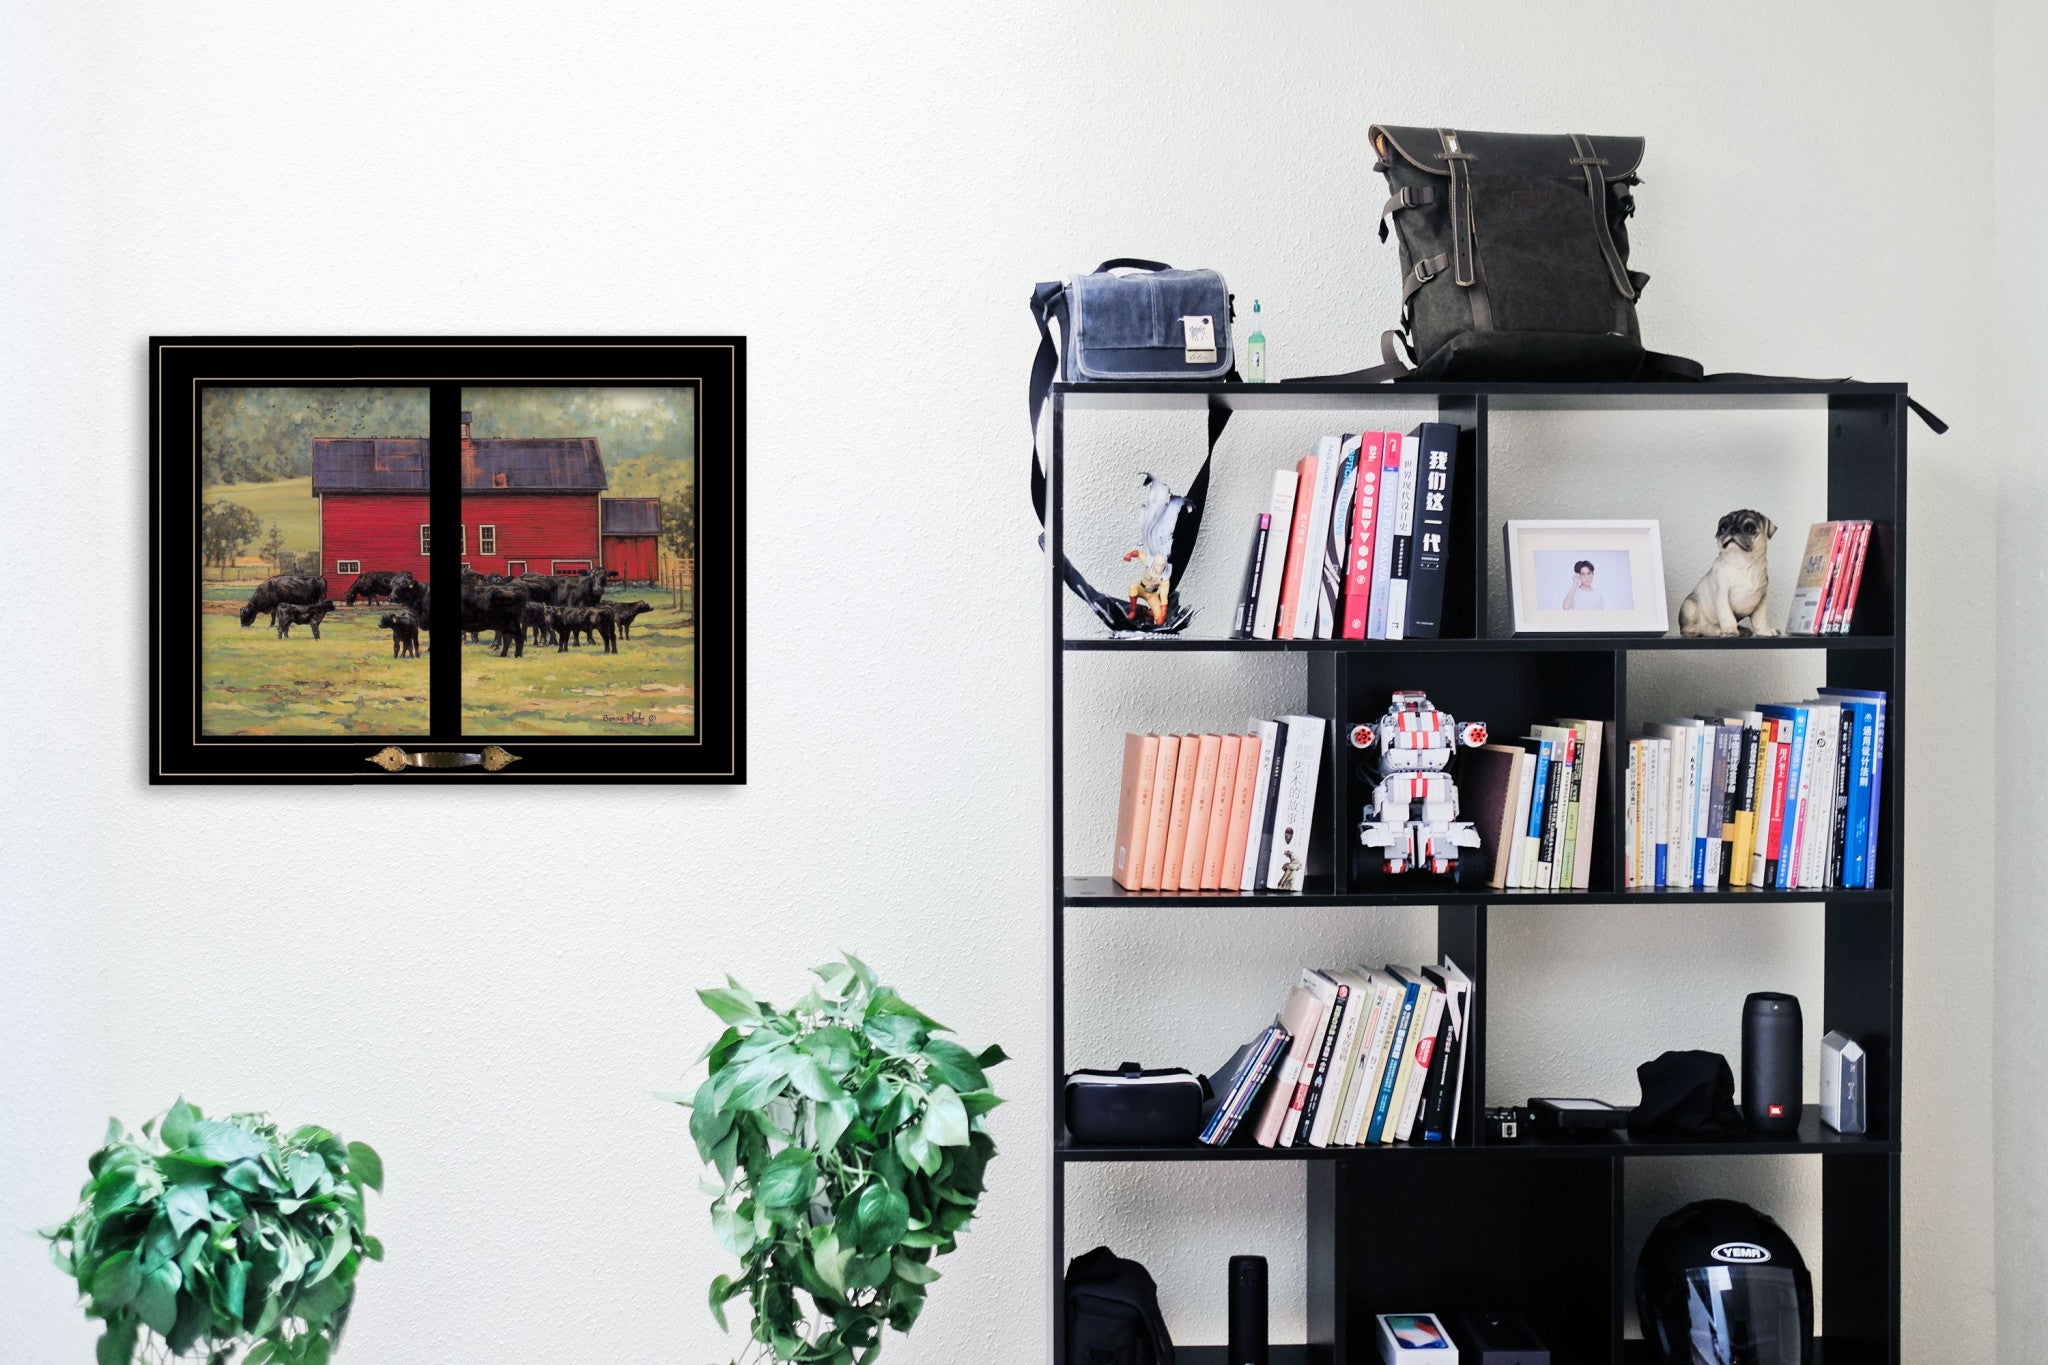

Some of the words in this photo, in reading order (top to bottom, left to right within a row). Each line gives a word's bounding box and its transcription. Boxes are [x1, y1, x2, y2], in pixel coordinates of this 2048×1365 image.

[1342, 448, 1355, 487] OPTICAL
[1336, 488, 1349, 537] ILLUSIONS
[1382, 474, 1395, 517] NAOTO
[1422, 450, 1448, 553] 我们这一代
[1377, 519, 1393, 583] FUKASAWA
[1859, 726, 1872, 787] 通用设计法则
[1287, 760, 1303, 825] 艺术的故事
[1722, 1247, 1761, 1259] YEMA
